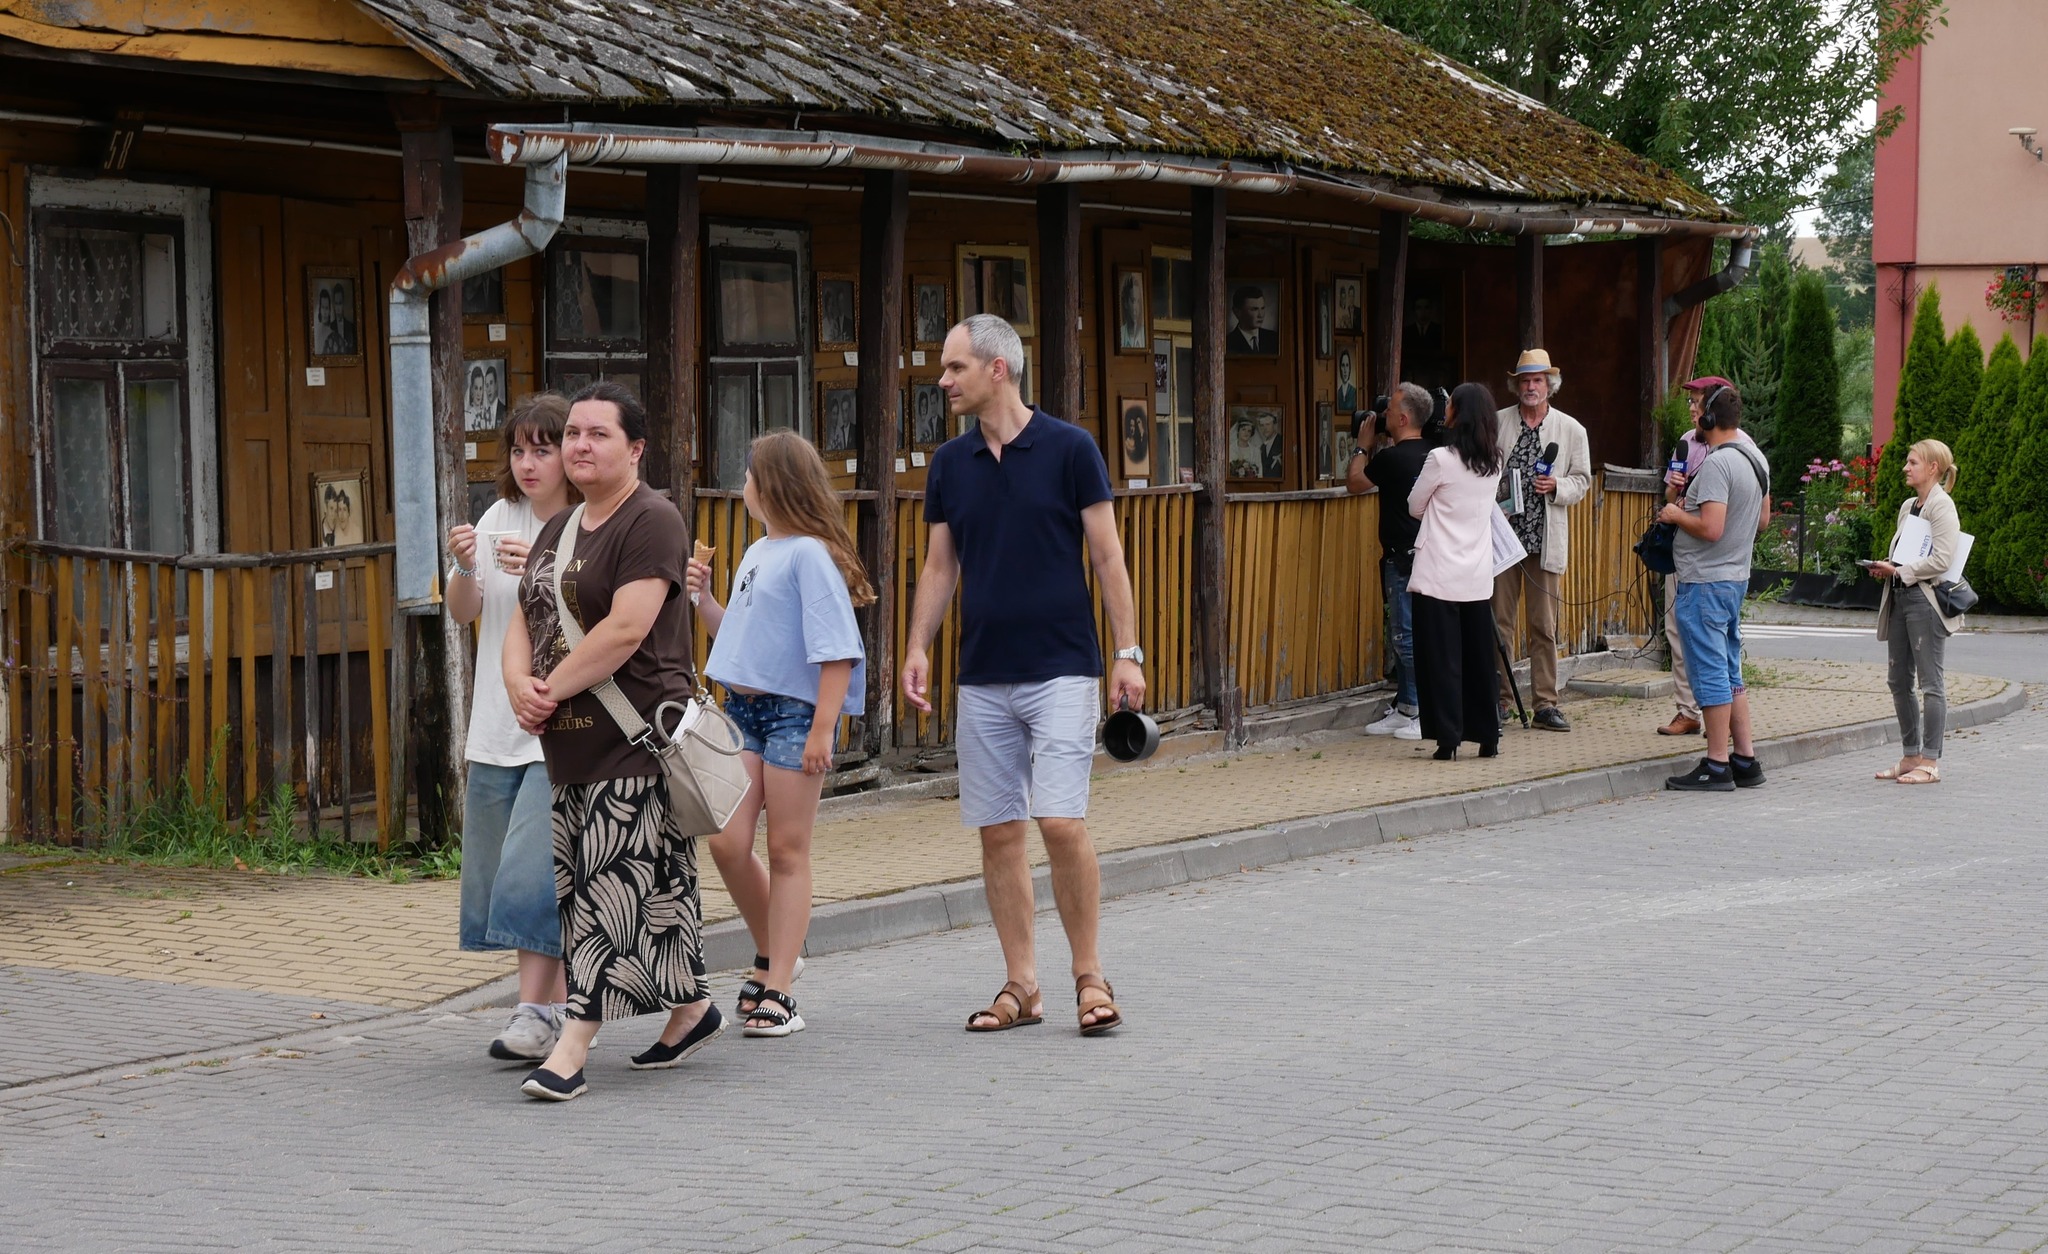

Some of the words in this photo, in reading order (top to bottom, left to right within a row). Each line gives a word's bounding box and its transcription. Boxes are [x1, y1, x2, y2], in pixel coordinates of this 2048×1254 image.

[103, 130, 135, 170] 58
[1918, 534, 1931, 558] LUBLIN
[546, 715, 594, 731] LEURS
